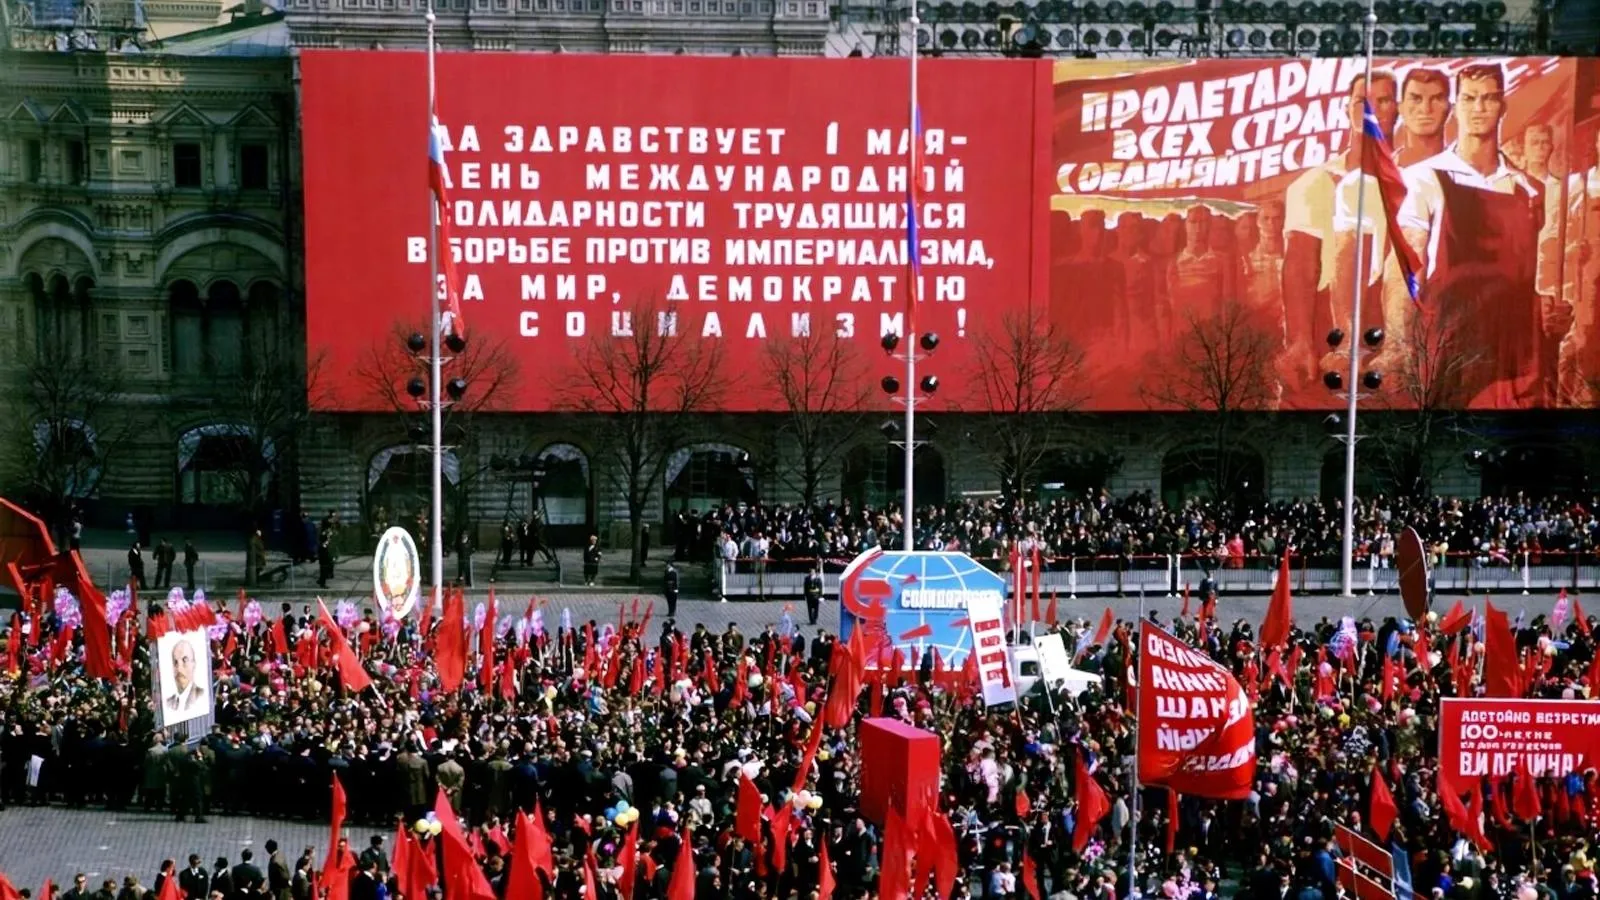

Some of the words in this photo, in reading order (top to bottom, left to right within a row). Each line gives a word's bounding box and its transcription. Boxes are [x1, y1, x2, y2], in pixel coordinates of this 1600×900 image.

[503, 125, 786, 156] ЗДРАВСТВУЕТ
[826, 121, 839, 155] 1
[1112, 121, 1213, 160] ВСЕХ
[1056, 130, 1343, 193] СОЕДИНЯЙТЕСЬ!
[407, 236, 427, 263] В
[586, 238, 711, 264] ПРОТИВ
[521, 274, 621, 304] МИР,
